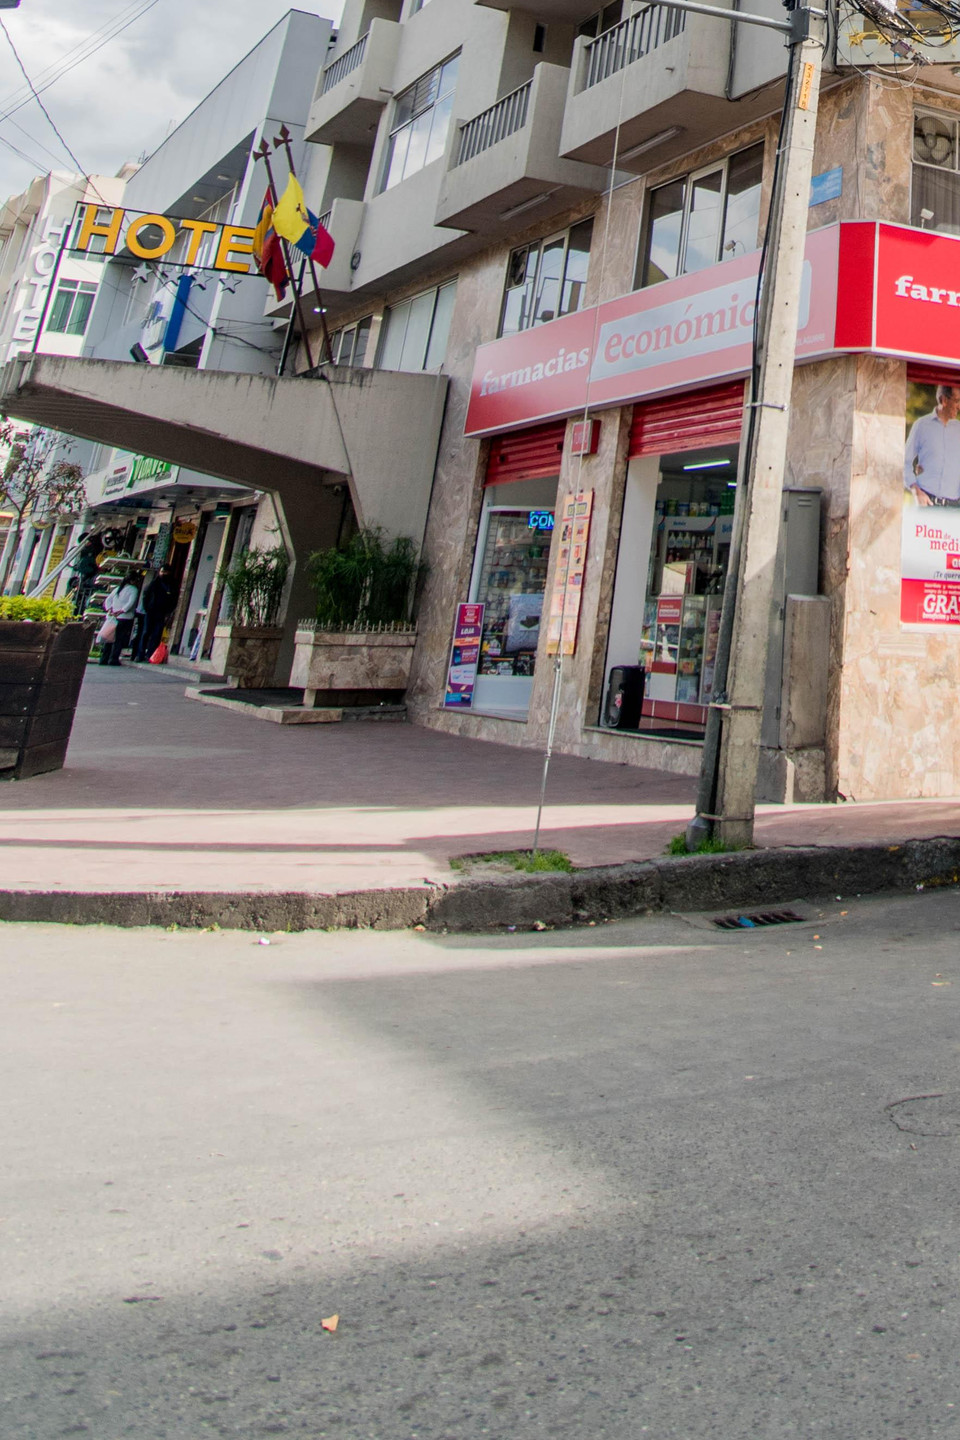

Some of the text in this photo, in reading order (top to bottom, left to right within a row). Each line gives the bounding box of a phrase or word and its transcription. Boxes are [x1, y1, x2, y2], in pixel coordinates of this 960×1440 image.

[77, 204, 290, 278] HOTE
[479, 345, 589, 397] farmacias
[915, 524, 943, 539] Plan
